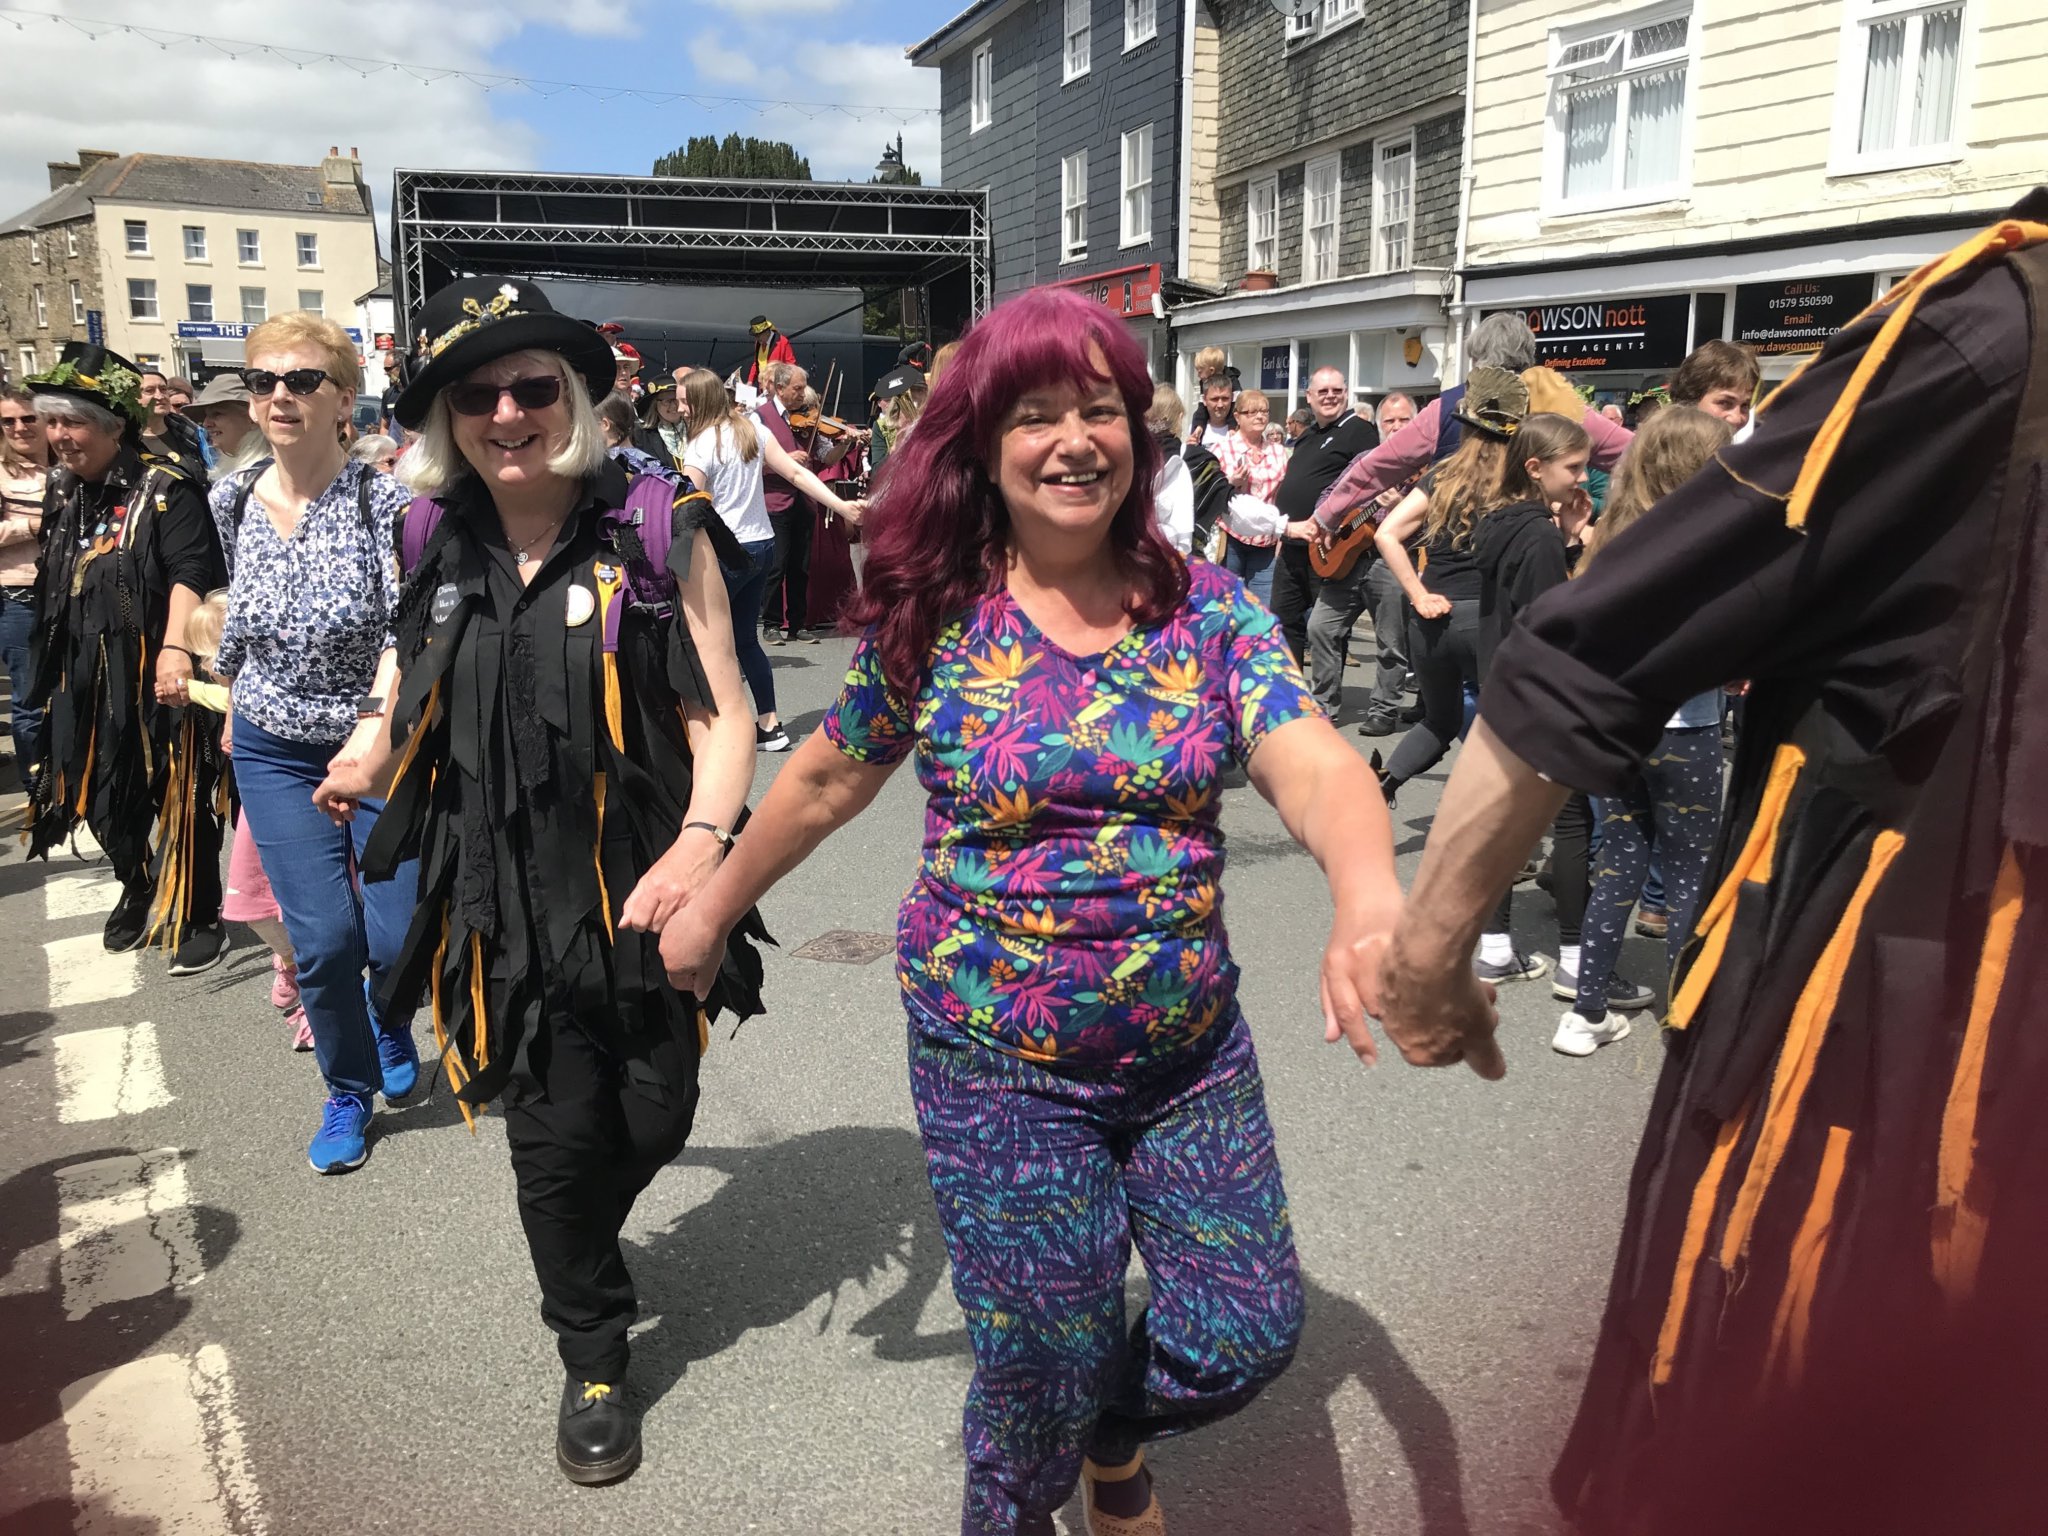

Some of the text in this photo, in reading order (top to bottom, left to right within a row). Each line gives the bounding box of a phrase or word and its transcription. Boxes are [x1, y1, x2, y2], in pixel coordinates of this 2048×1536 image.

[1784, 284, 1820, 295] Call Us:
[1769, 295, 1834, 309] 01579 550590
[1605, 304, 1646, 328] nott
[1784, 314, 1814, 325] Email:
[217, 325, 244, 337] THE
[1741, 326, 1840, 340] info@dawsonnott.co
[1581, 341, 1645, 352] AGENTS
[1263, 356, 1275, 370] Earl
[1544, 357, 1607, 369] Defining Excellence
